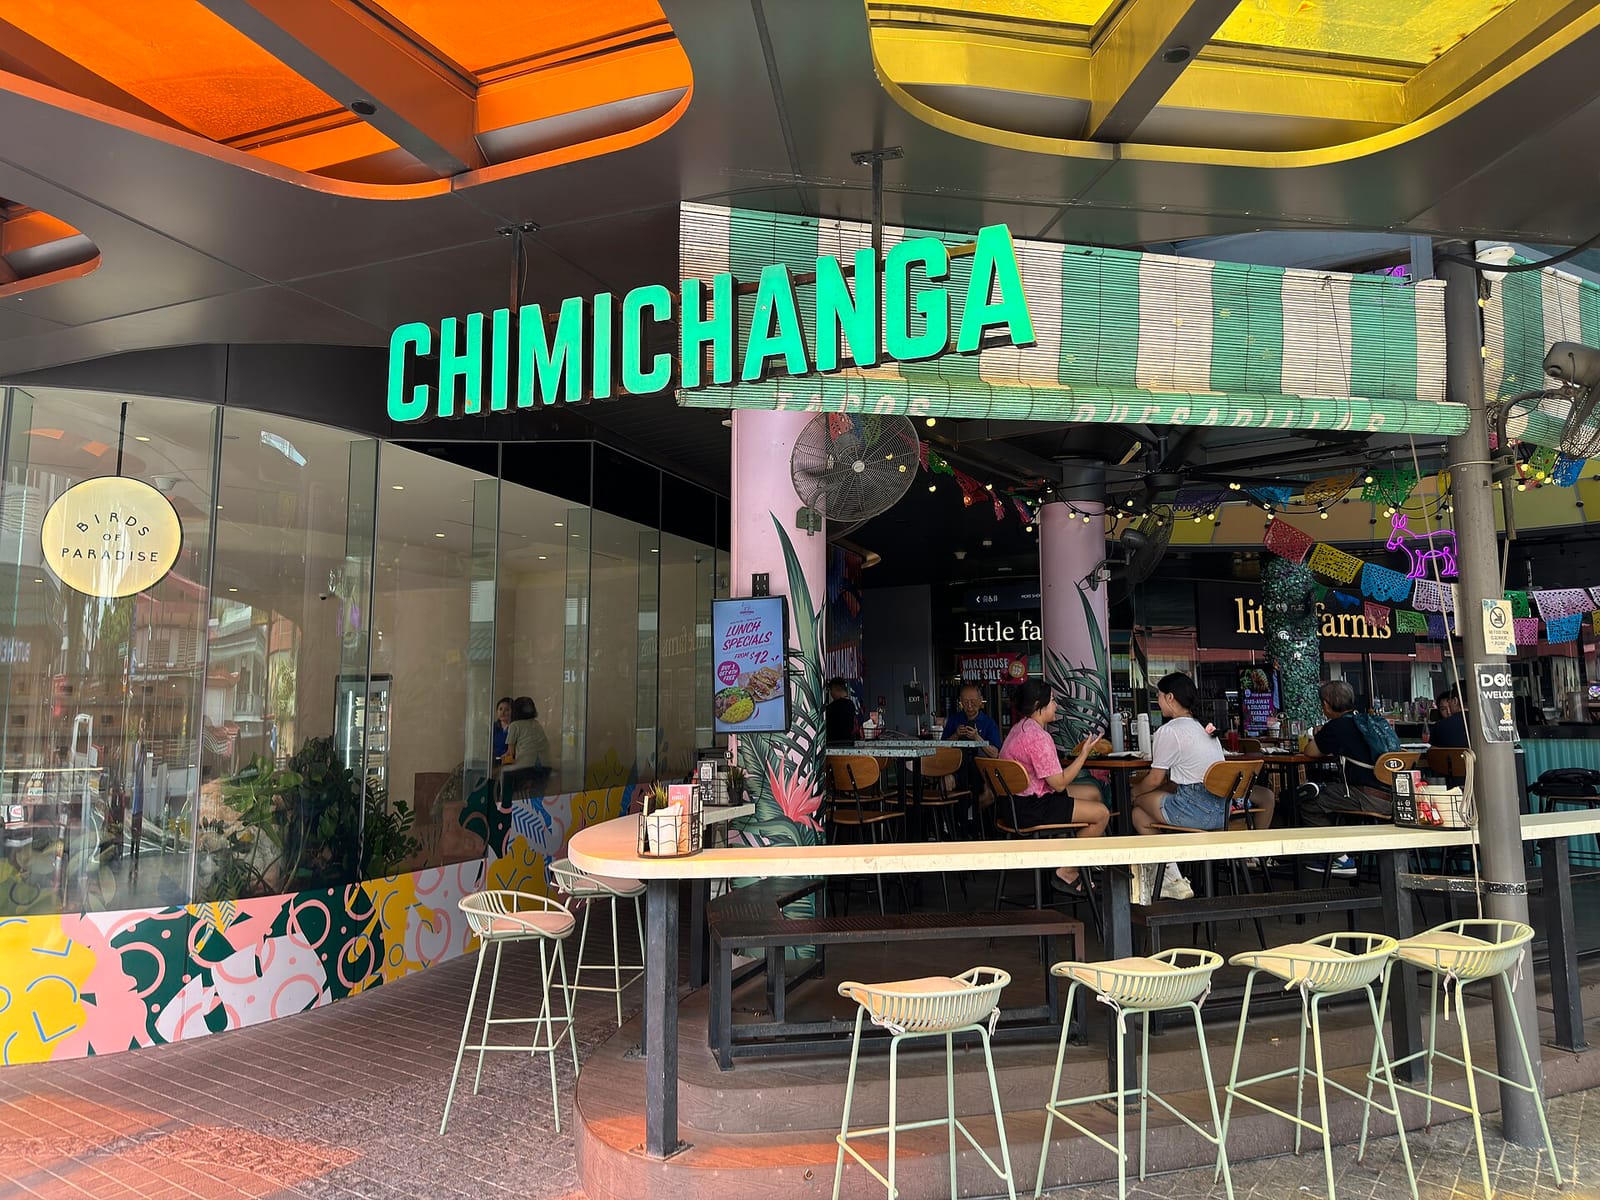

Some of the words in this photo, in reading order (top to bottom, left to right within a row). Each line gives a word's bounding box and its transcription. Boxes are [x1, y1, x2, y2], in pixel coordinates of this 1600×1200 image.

[387, 223, 1036, 422] CHIMICHANGA
[76, 512, 150, 536] BIRDS
[102, 533, 122, 541] OF
[61, 547, 159, 562] PARADISE
[1234, 597, 1265, 634] lit
[1315, 602, 1392, 639] farms
[726, 621, 761, 638] LUNCH
[964, 621, 1015, 642] little
[722, 631, 773, 651] SPECIALS
[749, 650, 769, 665] $12
[962, 657, 1009, 669] WAREHOUSE
[962, 669, 981, 680] WINE
[983, 669, 1002, 680] SALE
[1480, 673, 1513, 687] DOG
